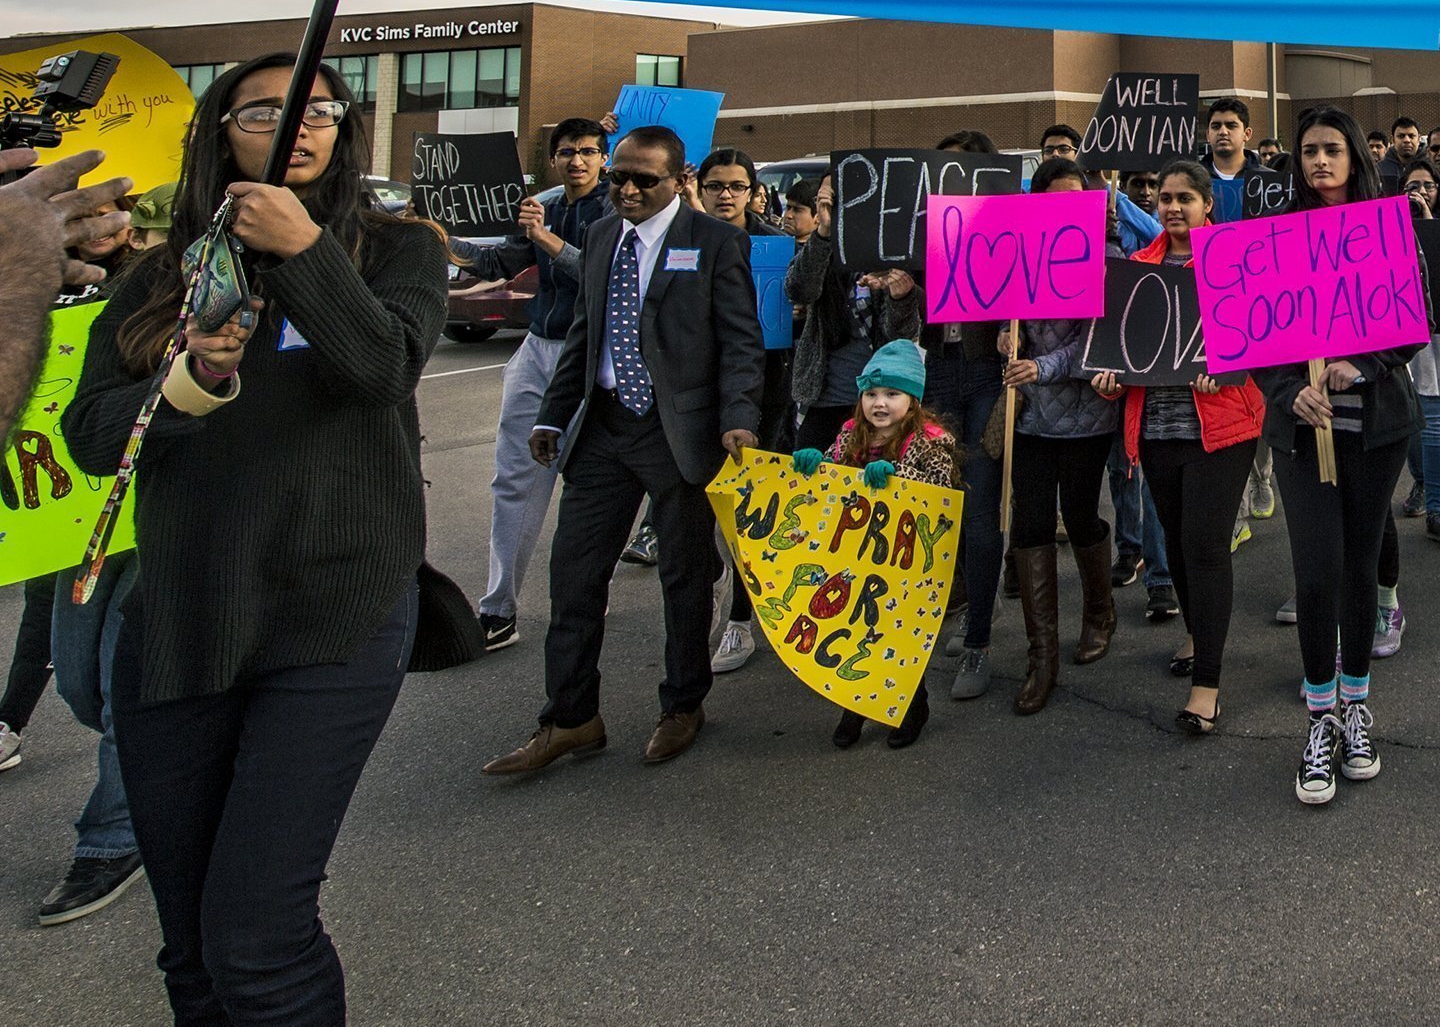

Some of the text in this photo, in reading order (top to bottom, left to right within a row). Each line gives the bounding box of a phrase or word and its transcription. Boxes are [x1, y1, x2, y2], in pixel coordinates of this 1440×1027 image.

[340, 19, 519, 43] KVC Sims Family Center
[93, 94, 138, 121] with
[143, 93, 174, 129] you
[619, 89, 672, 123] UNITY
[1115, 77, 1188, 108] WELL
[1080, 114, 1197, 155] OON IAN
[412, 137, 461, 182] STAND
[415, 182, 523, 227] TOGETHER
[835, 153, 1011, 265] PEA
[1246, 173, 1296, 217] get
[1201, 222, 1297, 296] Get
[1305, 201, 1409, 273] Well
[1212, 284, 1318, 362] Soon
[735, 490, 953, 574] WE PRAY
[782, 563, 889, 627] FOR
